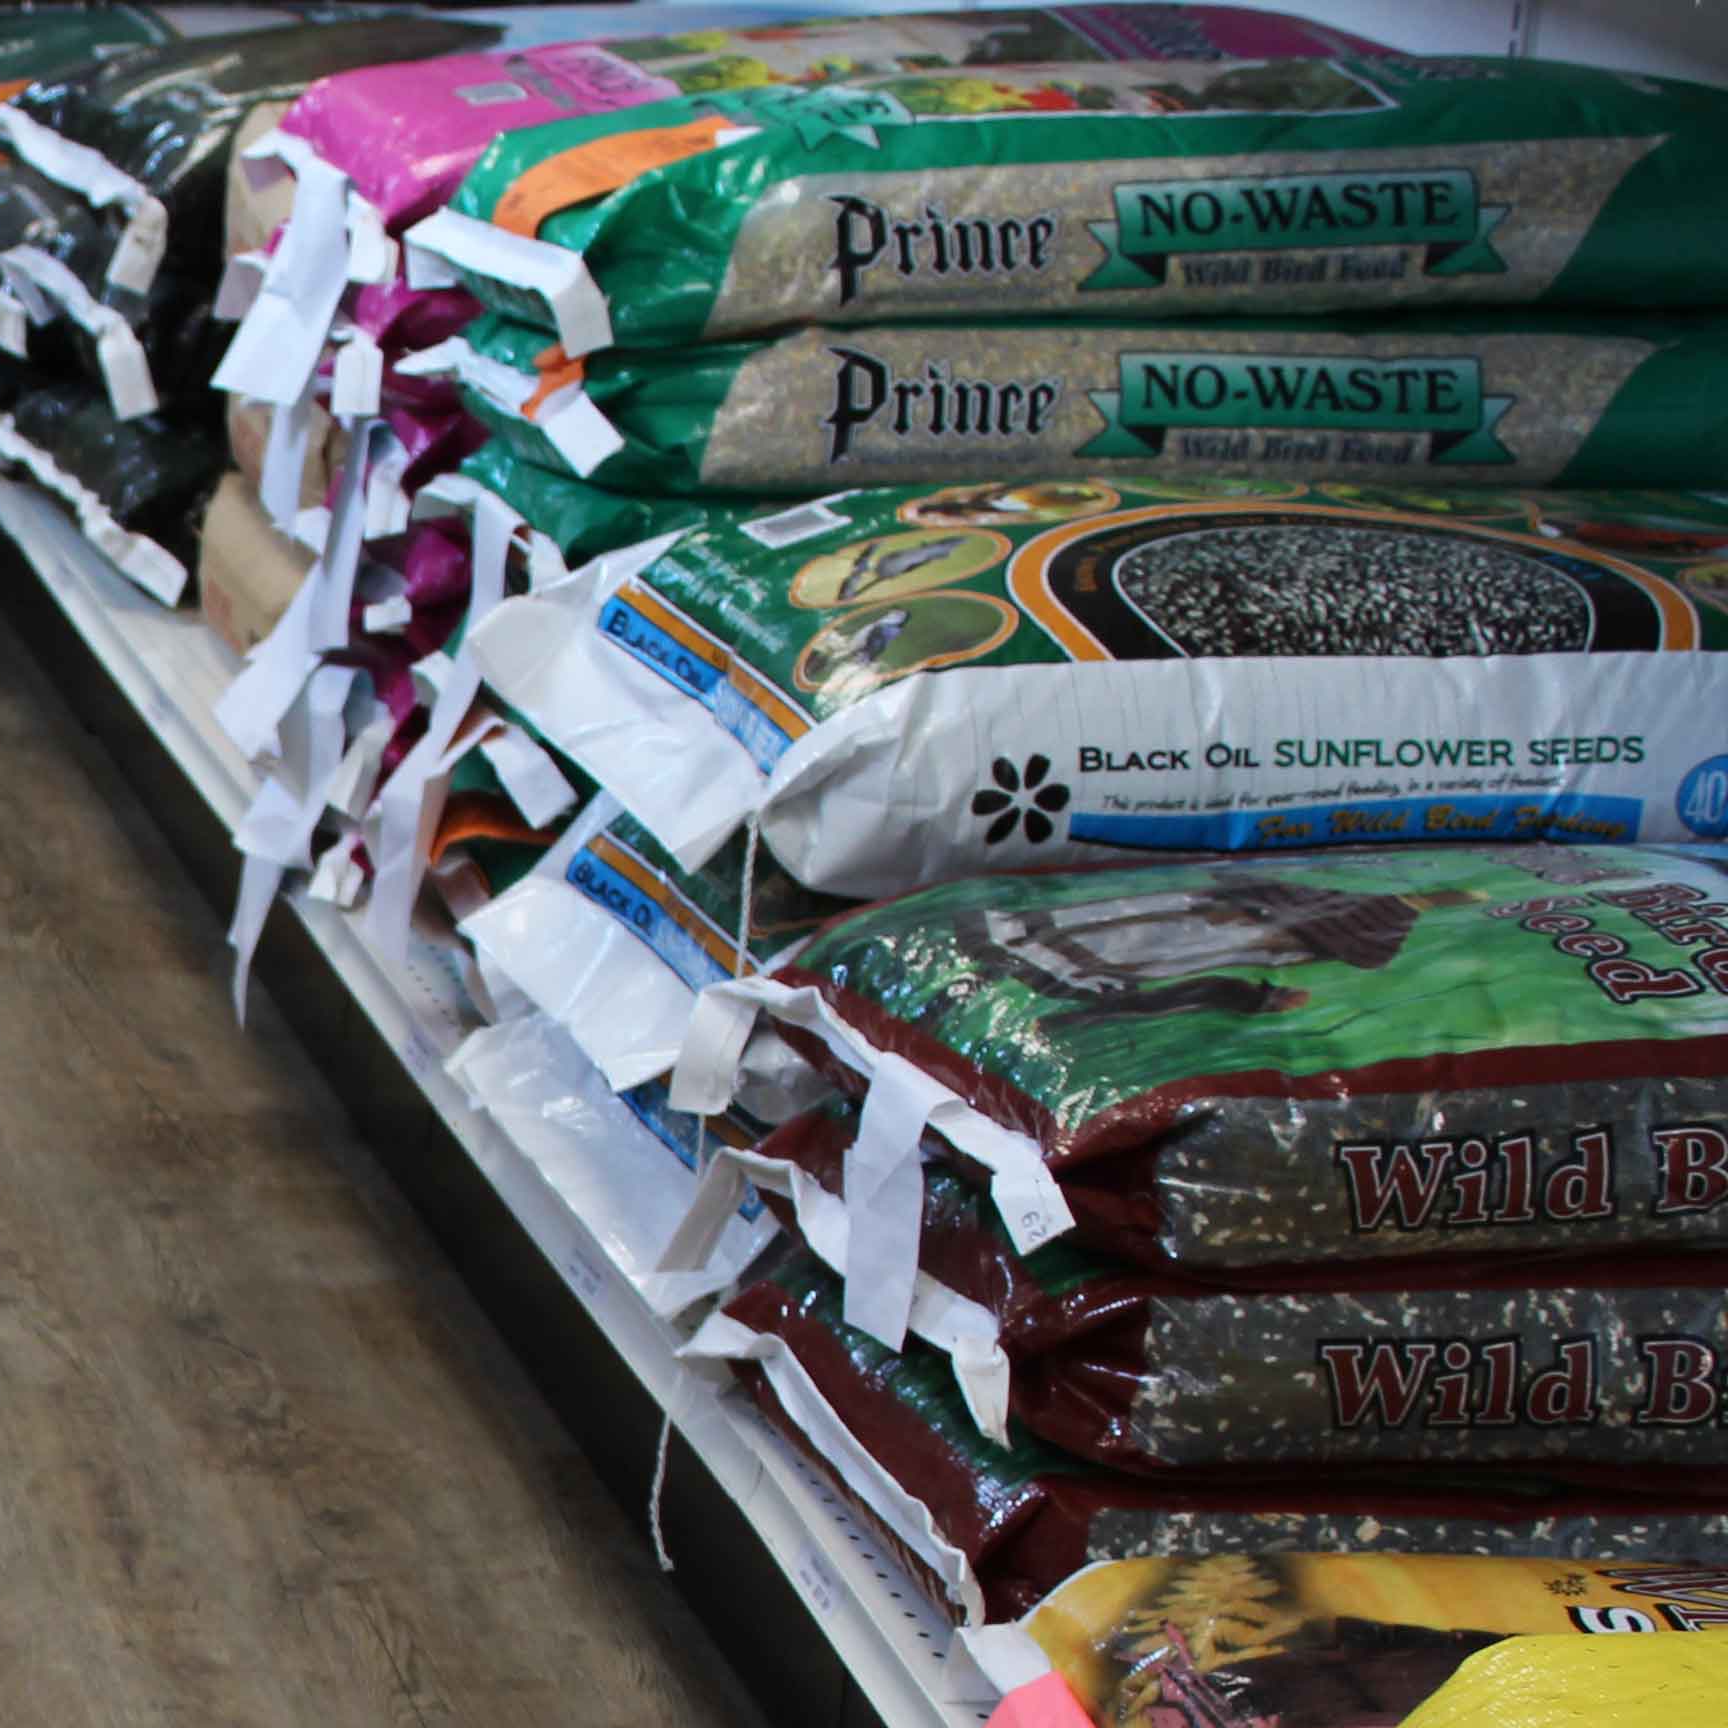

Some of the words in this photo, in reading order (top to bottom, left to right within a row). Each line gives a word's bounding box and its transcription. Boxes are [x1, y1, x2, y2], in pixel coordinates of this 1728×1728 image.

[825, 194, 1055, 306] Prince
[1138, 179, 1459, 239] NO-WASTE
[825, 346, 1058, 464] Prince
[1142, 362, 1464, 416] NO-WASTE
[1274, 738, 1516, 769] SUNFLOWER
[1528, 735, 1646, 766] SEEDS
[1331, 807, 1414, 834] Wild
[1424, 804, 1498, 832] Bird
[1484, 896, 1706, 1004] Seed
[1340, 1130, 1614, 1230] Wild
[1322, 1339, 1597, 1427] Wild
